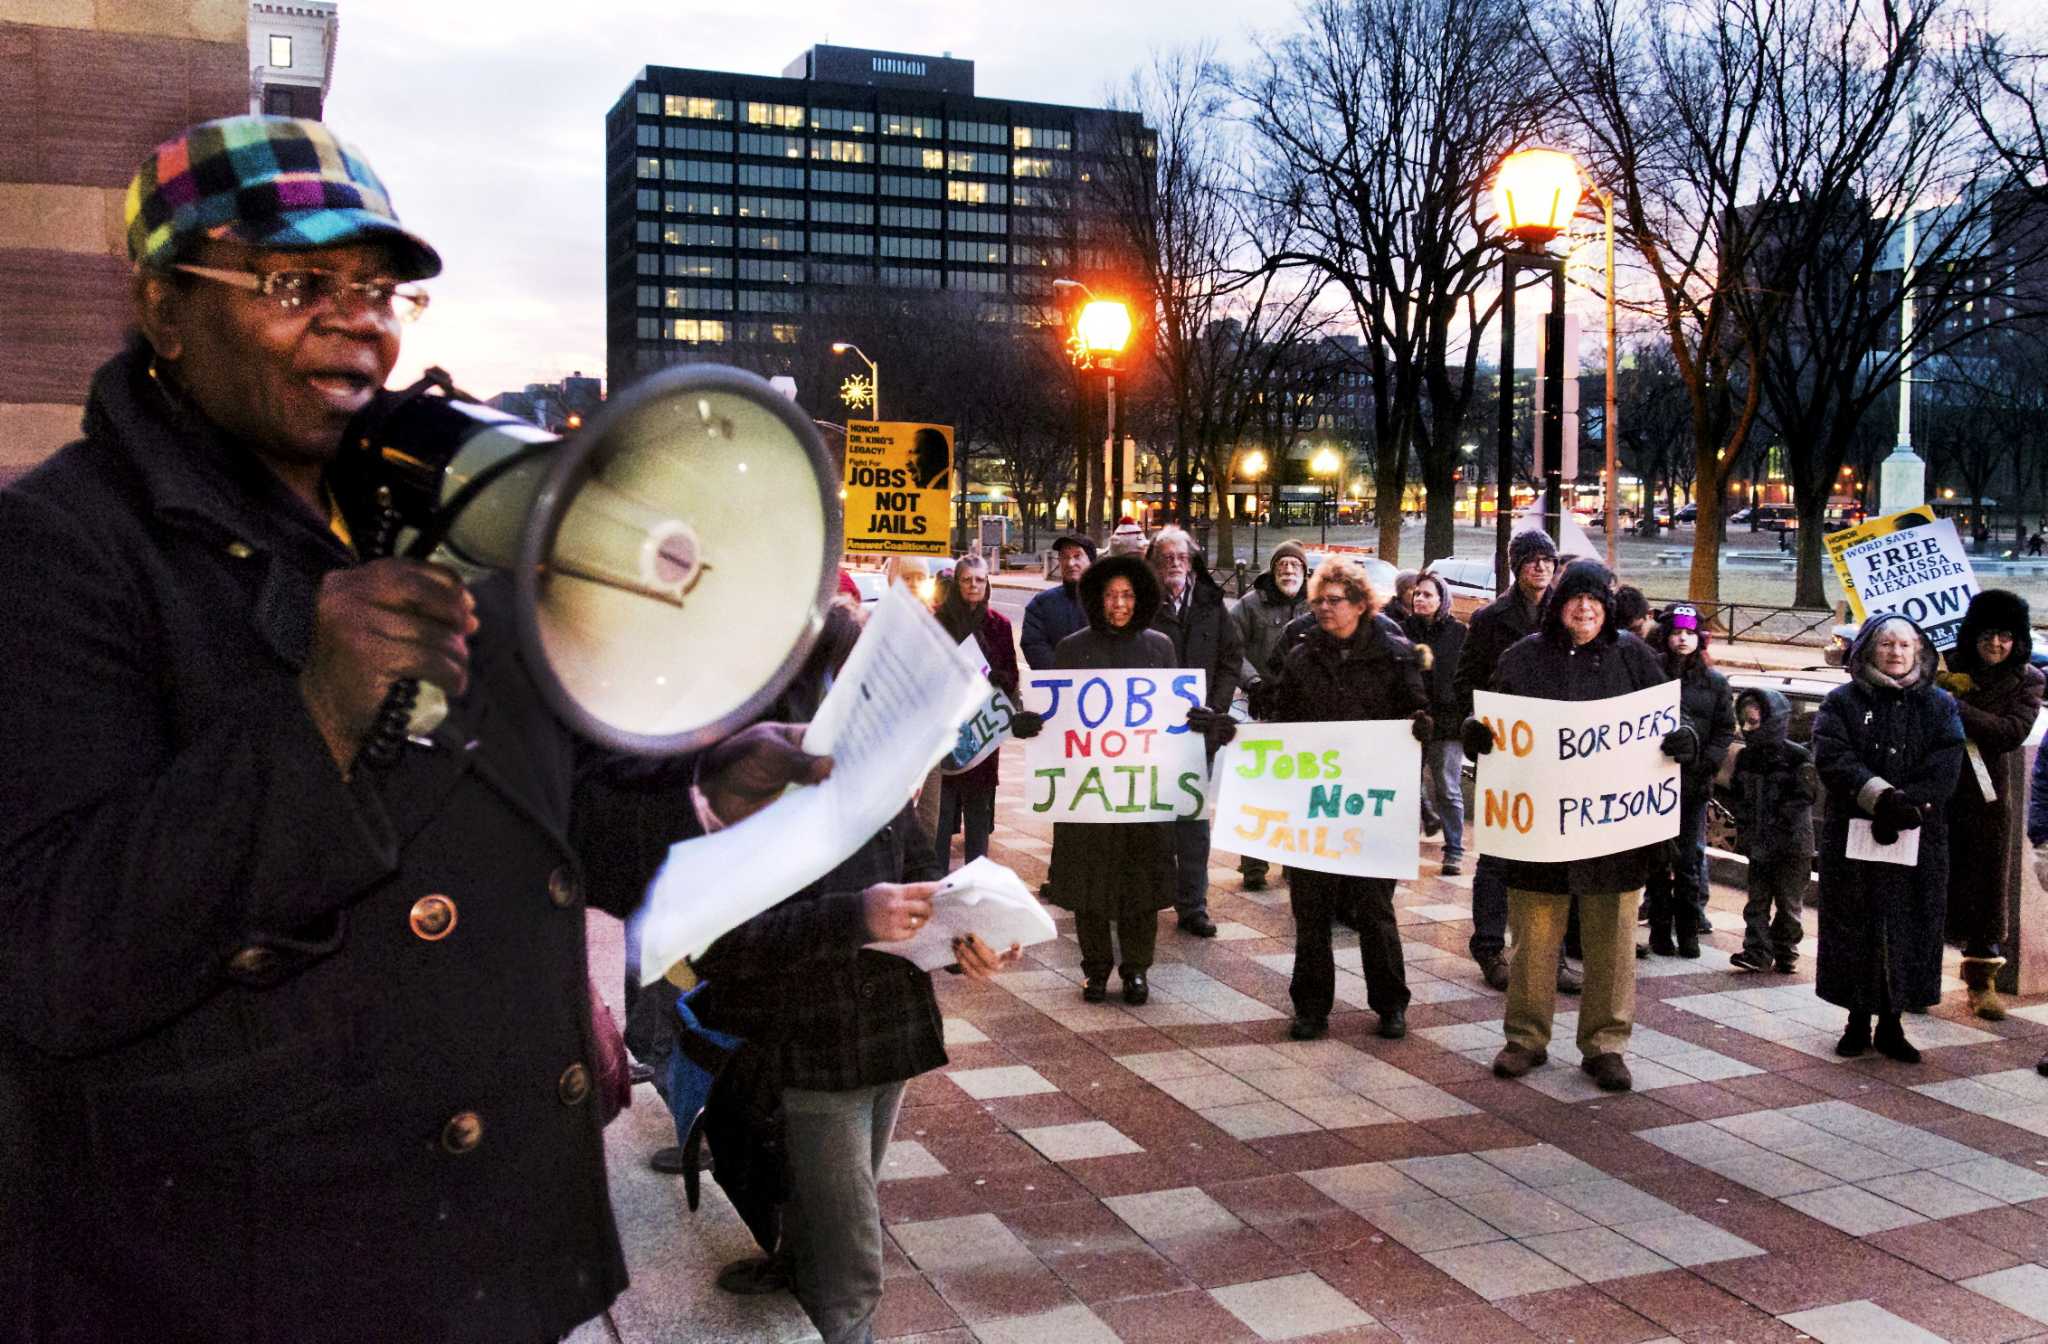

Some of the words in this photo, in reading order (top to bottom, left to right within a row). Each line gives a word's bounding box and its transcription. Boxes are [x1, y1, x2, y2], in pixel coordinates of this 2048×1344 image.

[848, 466, 907, 488] JOBS
[875, 491, 921, 512] NOT
[867, 514, 928, 535] JAILS
[1846, 538, 1883, 558] WORD
[1866, 537, 1941, 572] FREE
[1863, 562, 1965, 600] ALEXANDER
[1869, 554, 1950, 585] MARISSA
[1030, 675, 1201, 734] JOBS
[1064, 729, 1158, 758] NOT
[1481, 715, 1535, 758] NO
[1558, 705, 1677, 760] BORDERS
[1032, 765, 1204, 822] JAILS
[1484, 788, 1535, 834] NO
[1559, 776, 1678, 836] PRISONS
[1233, 804, 1363, 860] JAILS
